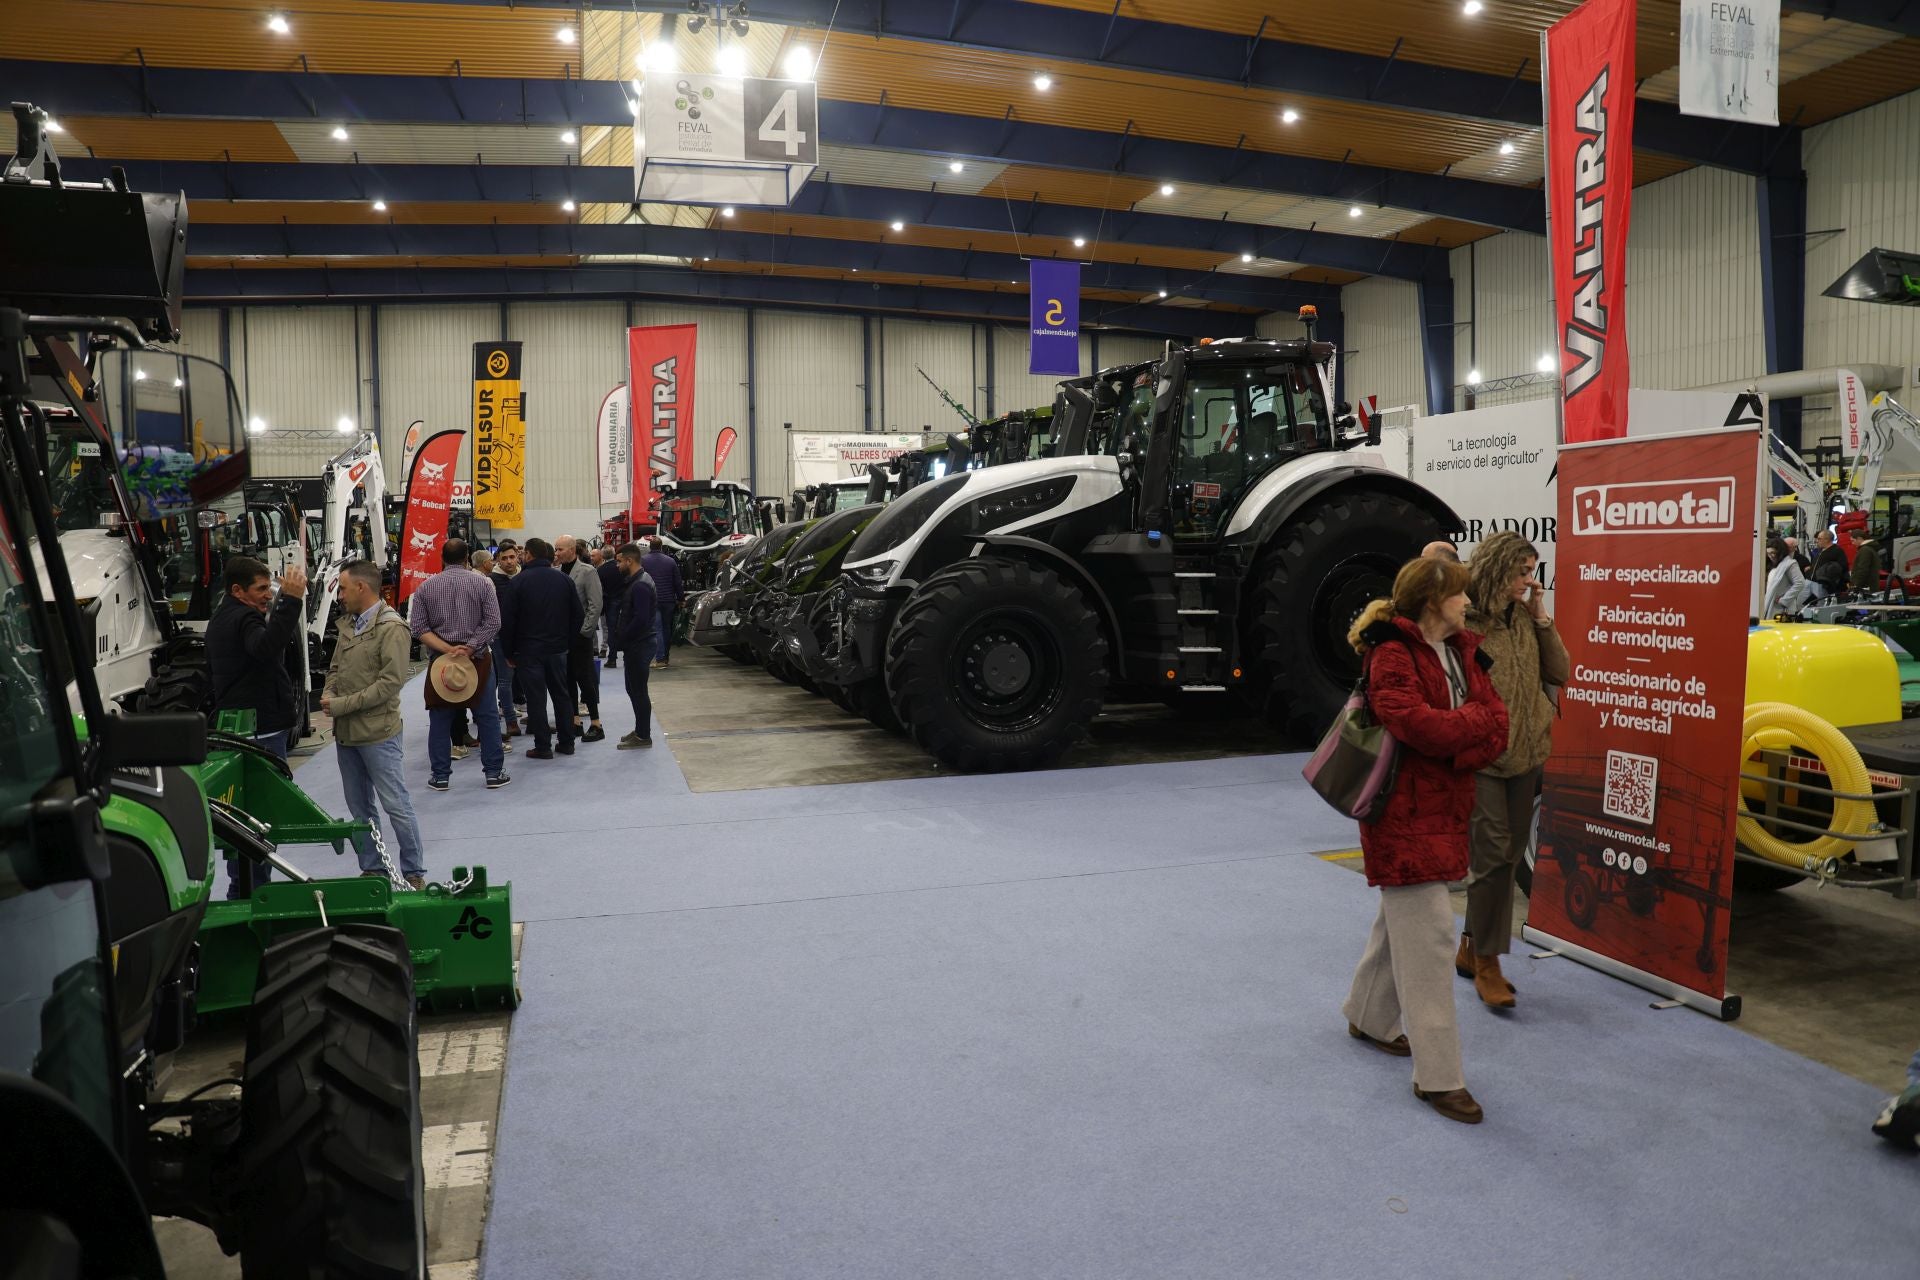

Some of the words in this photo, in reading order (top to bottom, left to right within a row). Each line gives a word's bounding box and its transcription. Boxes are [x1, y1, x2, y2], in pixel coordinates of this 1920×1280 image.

[1711, 2, 1755, 26] FEVAL
[678, 121, 712, 134] FEVAL
[758, 89, 807, 156] 4
[1564, 62, 1611, 401] VALTRA
[648, 355, 677, 489] VALTRA
[476, 388, 494, 496] VIDELSUR
[1466, 432, 1517, 450] tecnología
[841, 450, 880, 460] TALLERES
[1426, 459, 1434, 472] al
[1437, 456, 1471, 471] servicio
[1473, 454, 1489, 468] del
[421, 500, 446, 510] Bobcat
[1576, 486, 1730, 532] Remotal
[1579, 564, 1612, 581] Taller
[1615, 564, 1720, 586] especializado
[1598, 605, 1685, 627] Fabricación
[1588, 626, 1608, 643] de
[1611, 629, 1694, 653] remolques
[1575, 664, 1681, 693] Concesionario
[1684, 676, 1706, 696] de
[1566, 686, 1647, 709] maquinaria
[1651, 695, 1716, 720] agrícola
[1600, 710, 1609, 728] y
[1612, 711, 1671, 735] forestal
[1585, 822, 1671, 853] www.remotal.es
